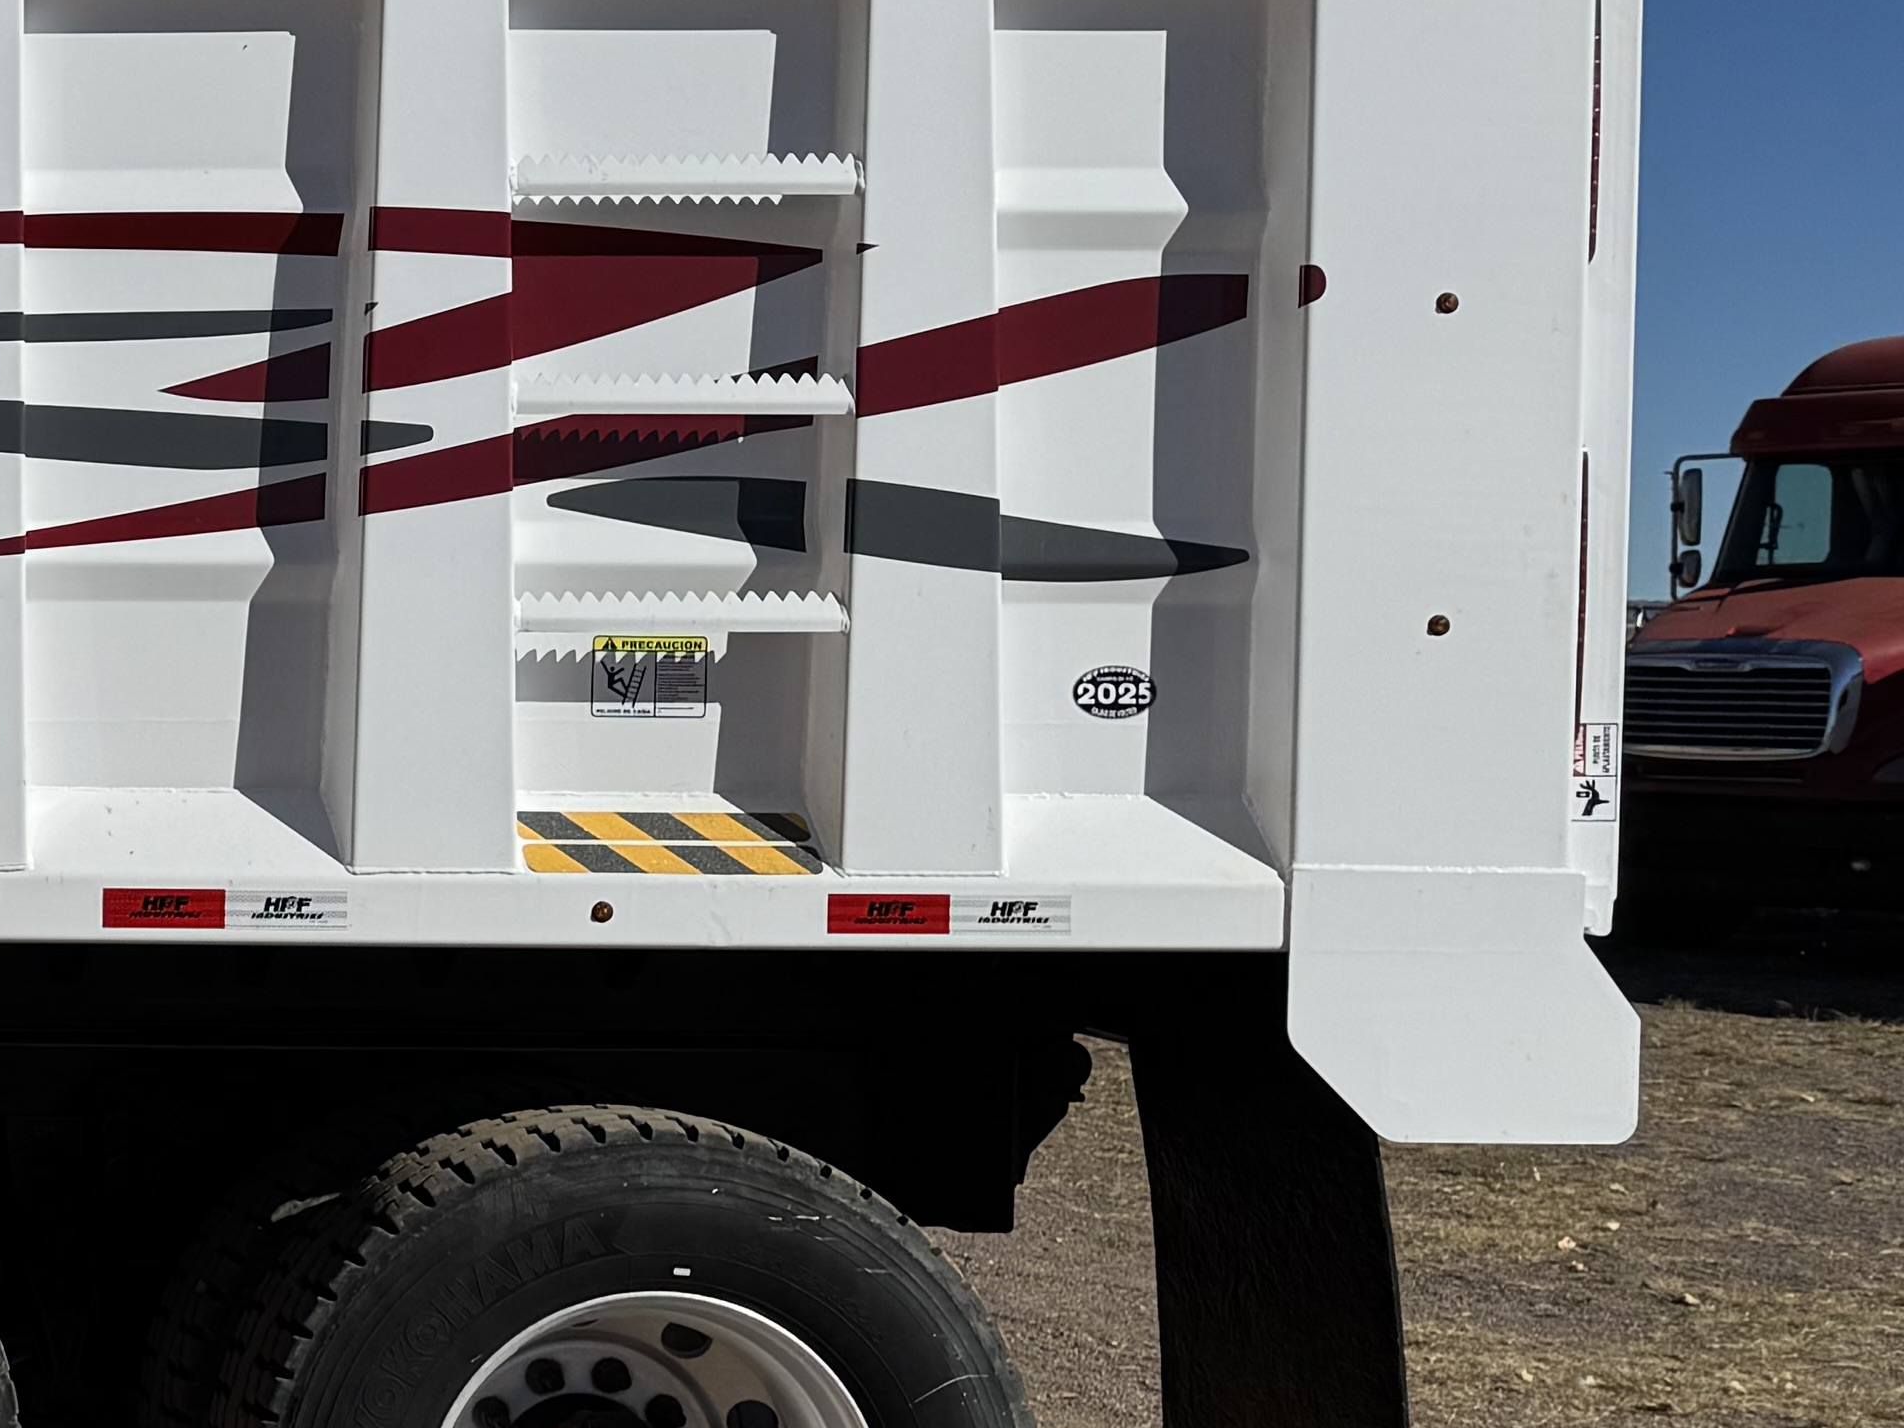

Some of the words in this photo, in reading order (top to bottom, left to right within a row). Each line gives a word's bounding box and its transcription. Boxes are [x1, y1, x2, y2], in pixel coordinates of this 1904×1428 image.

[1076, 682, 1152, 705] 2025
[250, 911, 324, 919] INDUSTRIES
[977, 916, 1049, 924] INDUSTRIES
